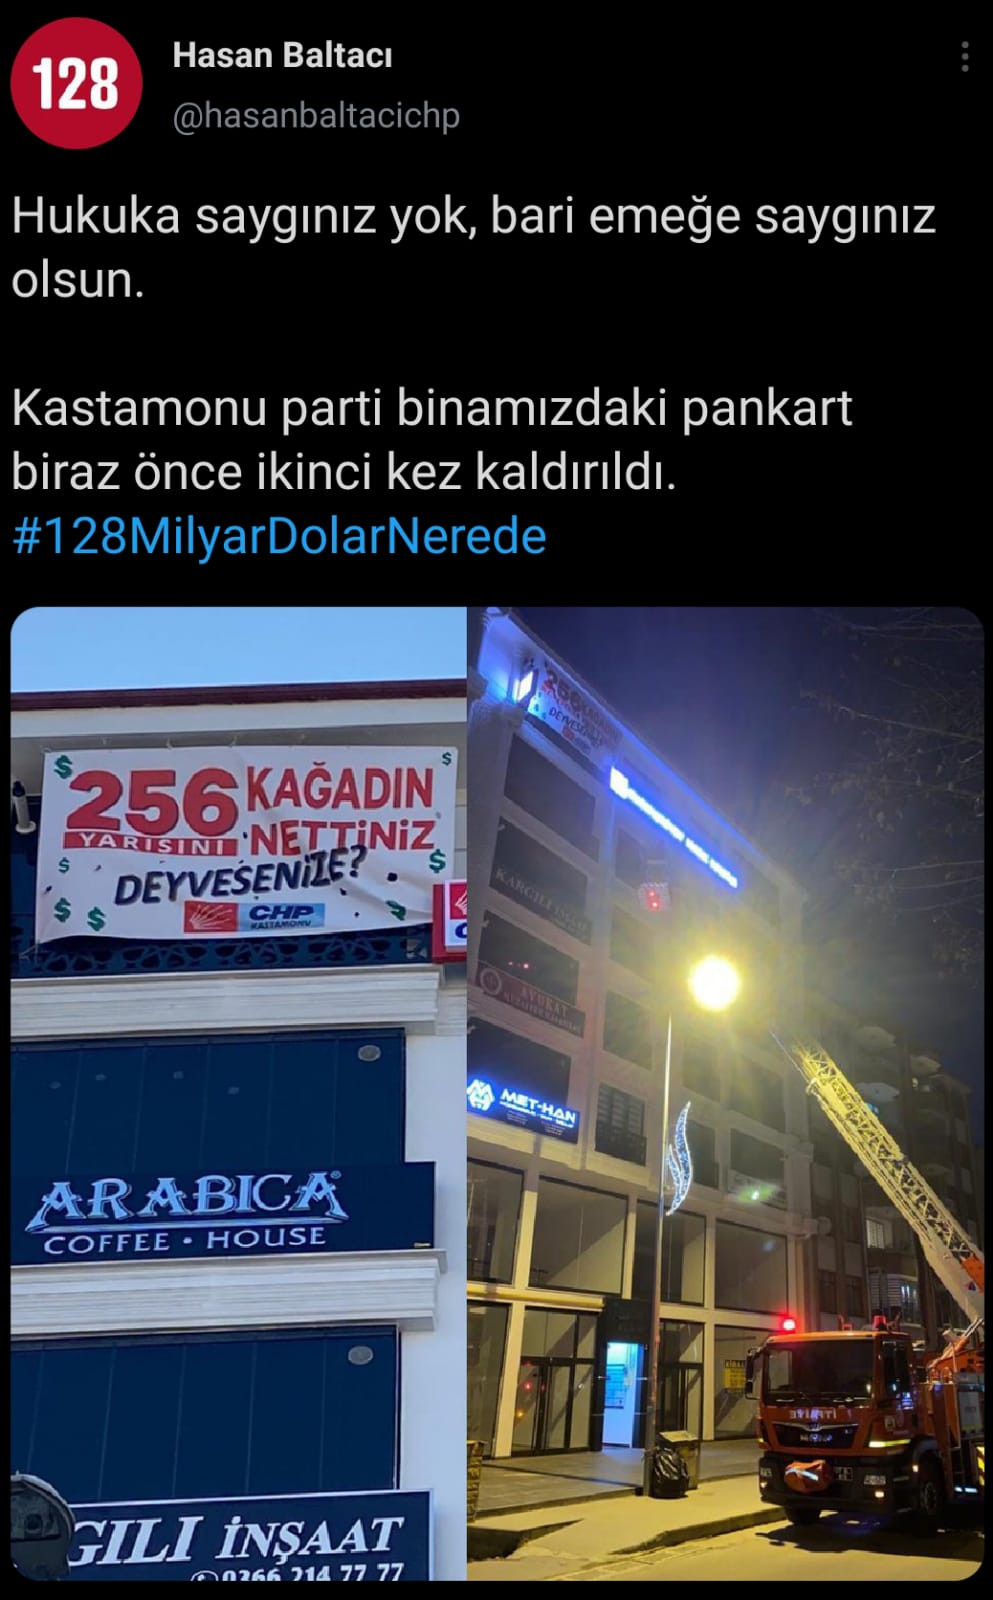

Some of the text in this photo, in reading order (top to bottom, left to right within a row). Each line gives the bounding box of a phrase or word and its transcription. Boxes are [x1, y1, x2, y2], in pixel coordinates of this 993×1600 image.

[67, 761, 433, 837] 256 KAĞADIN
[79, 833, 223, 856] YARISINI
[249, 904, 314, 920] CHP
[500, 1088, 576, 1125] MET-HAN
[43, 1227, 327, 1255] COFFEE HOUSE
[68, 1515, 406, 1567] GILI İNŞAAT
[291, 1565, 331, 1581] 214
[340, 1564, 367, 1581] 77
[377, 1562, 405, 1581] 77
